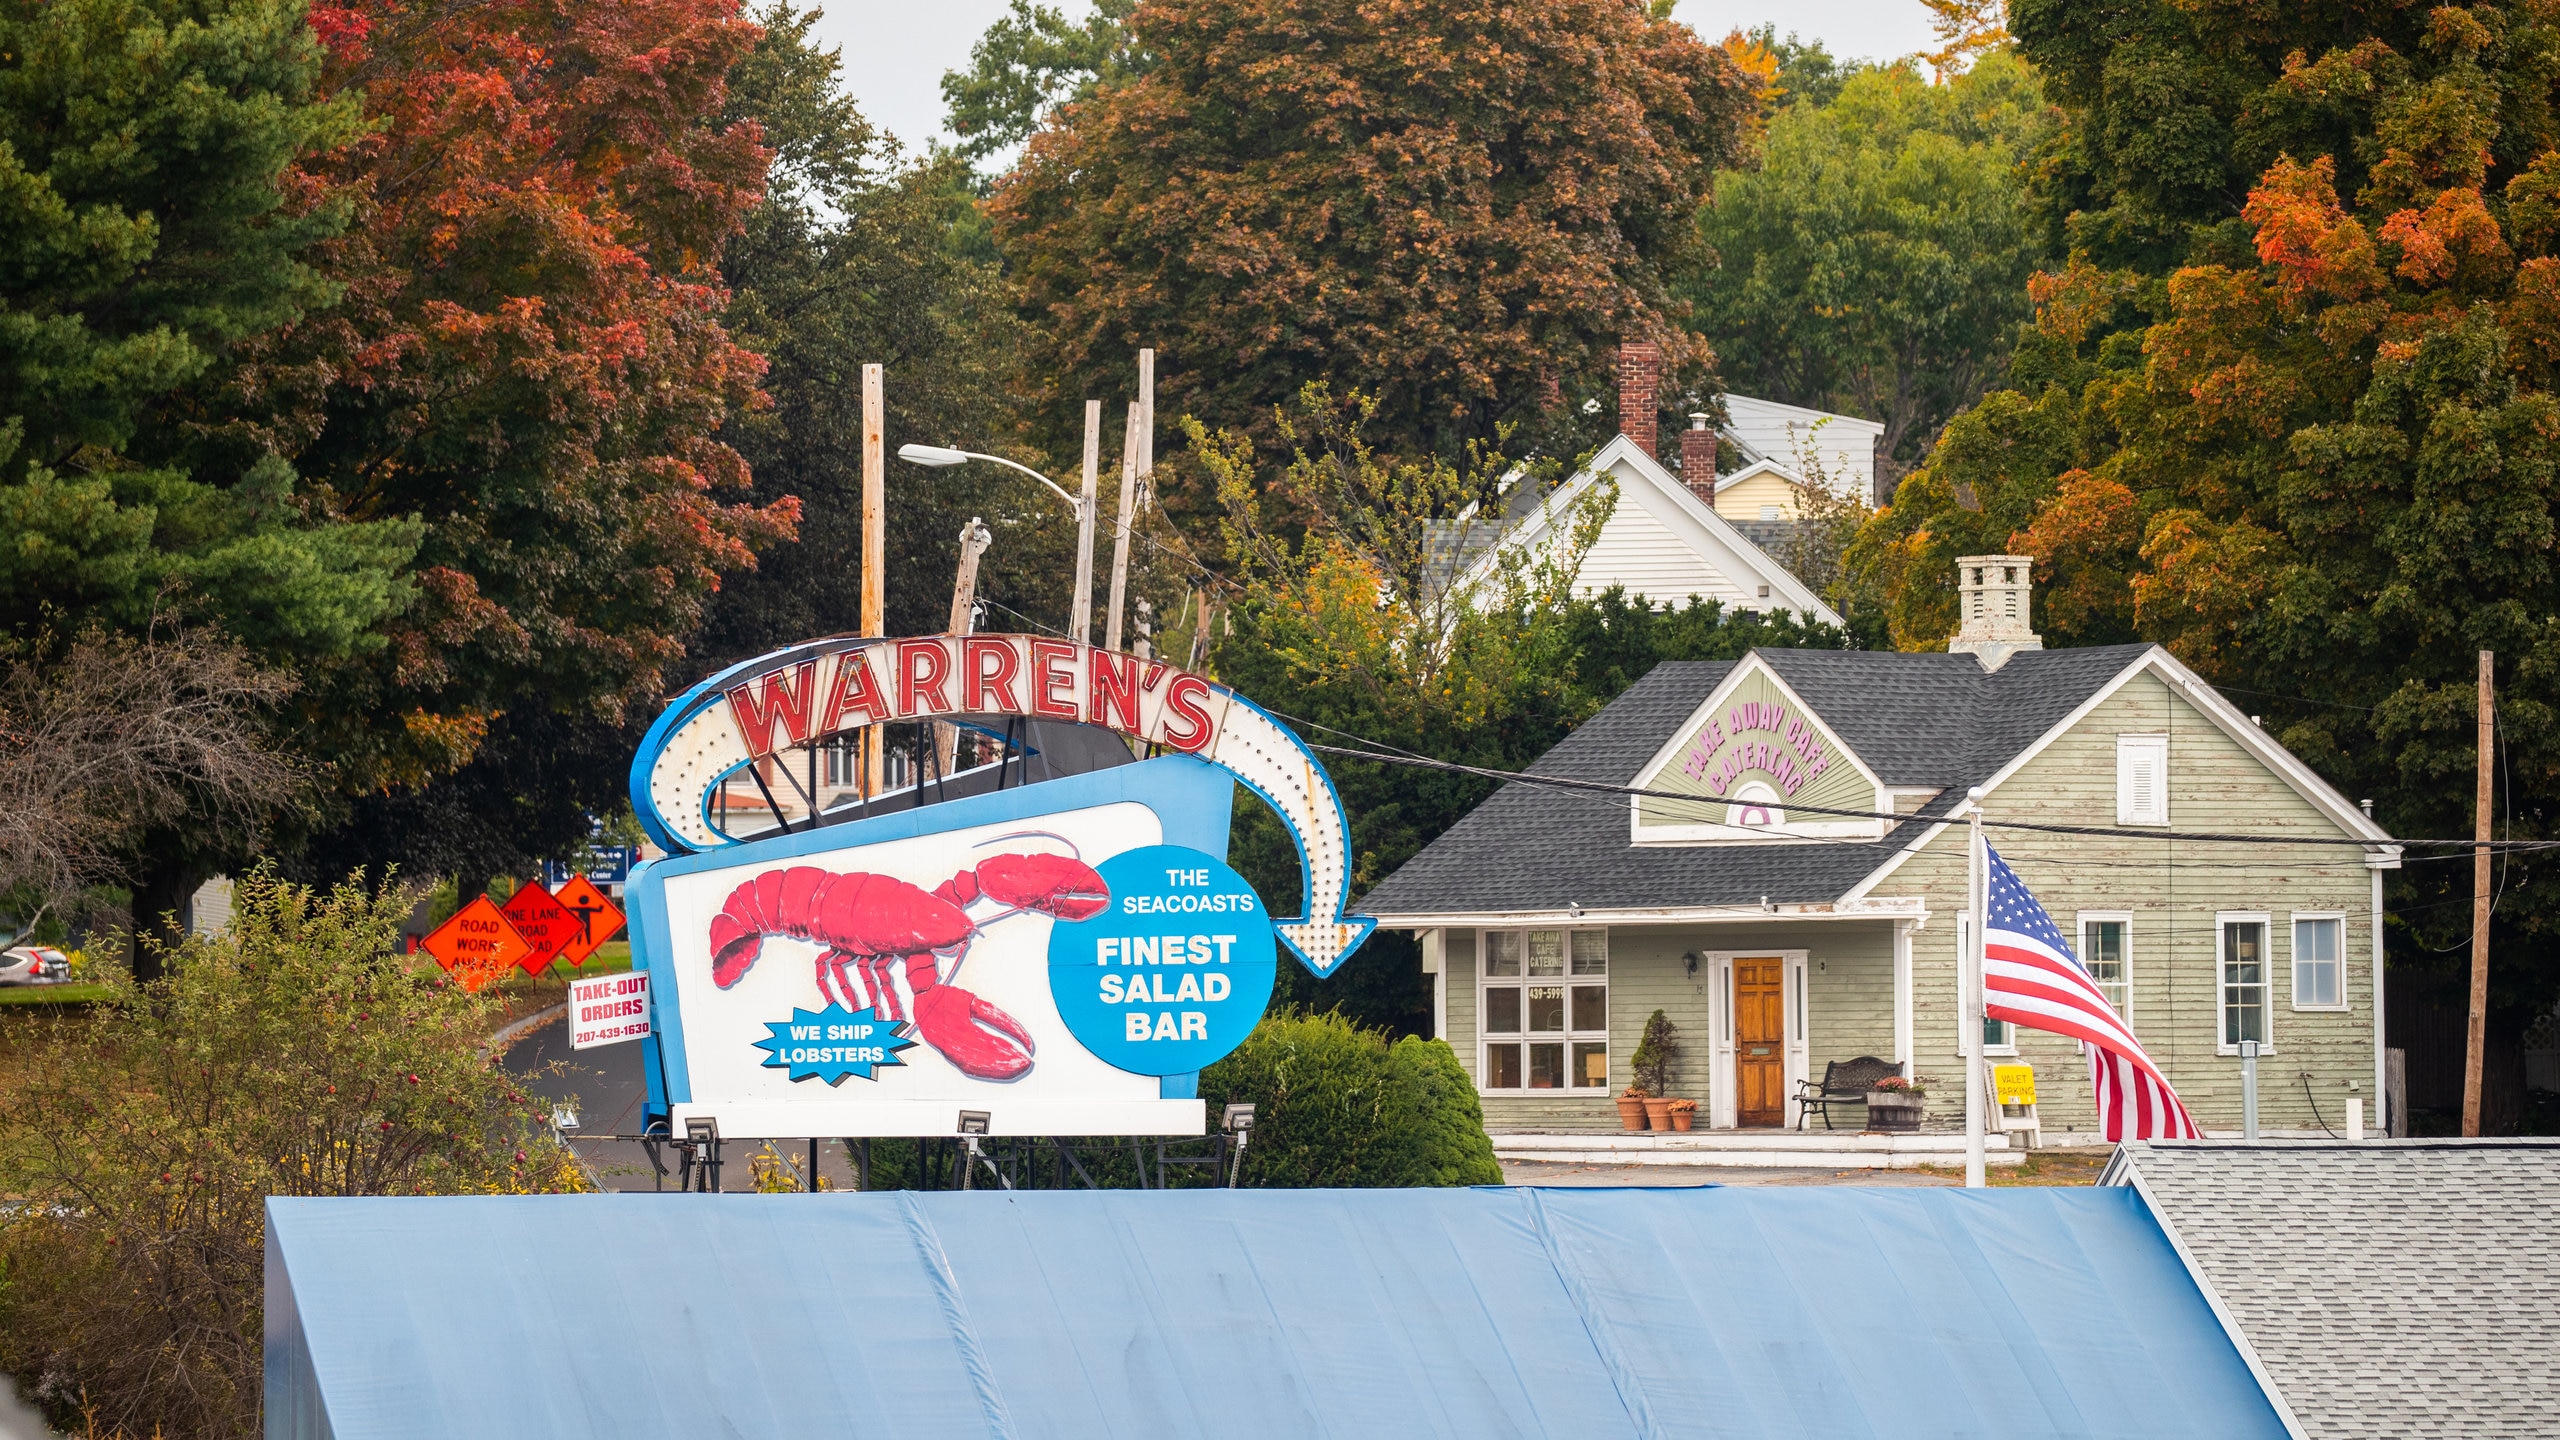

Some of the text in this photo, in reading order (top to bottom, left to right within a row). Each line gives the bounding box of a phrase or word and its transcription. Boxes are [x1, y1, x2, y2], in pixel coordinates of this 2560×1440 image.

[730, 637, 1215, 758] WARREN'S
[1683, 701, 1829, 781] TAKE AWAY CAFE
[1708, 741, 1804, 797] CATERING
[1166, 869, 1210, 887] THE
[1123, 894, 1254, 914] SEACOASTS
[531, 907, 561, 921] LANE
[459, 920, 499, 934] ROAD
[457, 938, 499, 952] WORK
[1097, 934, 1237, 966] FINEST
[1536, 943, 1555, 955] CAFE
[1529, 956, 1563, 968] CATERING
[574, 976, 648, 1002] TAKE-OUT
[1099, 973, 1231, 1004] SALAD
[1529, 987, 1565, 1000] 439-5999
[581, 999, 643, 1023] ORDERS
[576, 1022, 650, 1044] 207-439-1630
[789, 1025, 873, 1041] WE SHIP
[1125, 1012, 1207, 1041] BAR
[780, 1047, 885, 1063] LOBSTERS
[2001, 1074, 2027, 1084] VALET
[1997, 1086, 2035, 1096] PARKING
